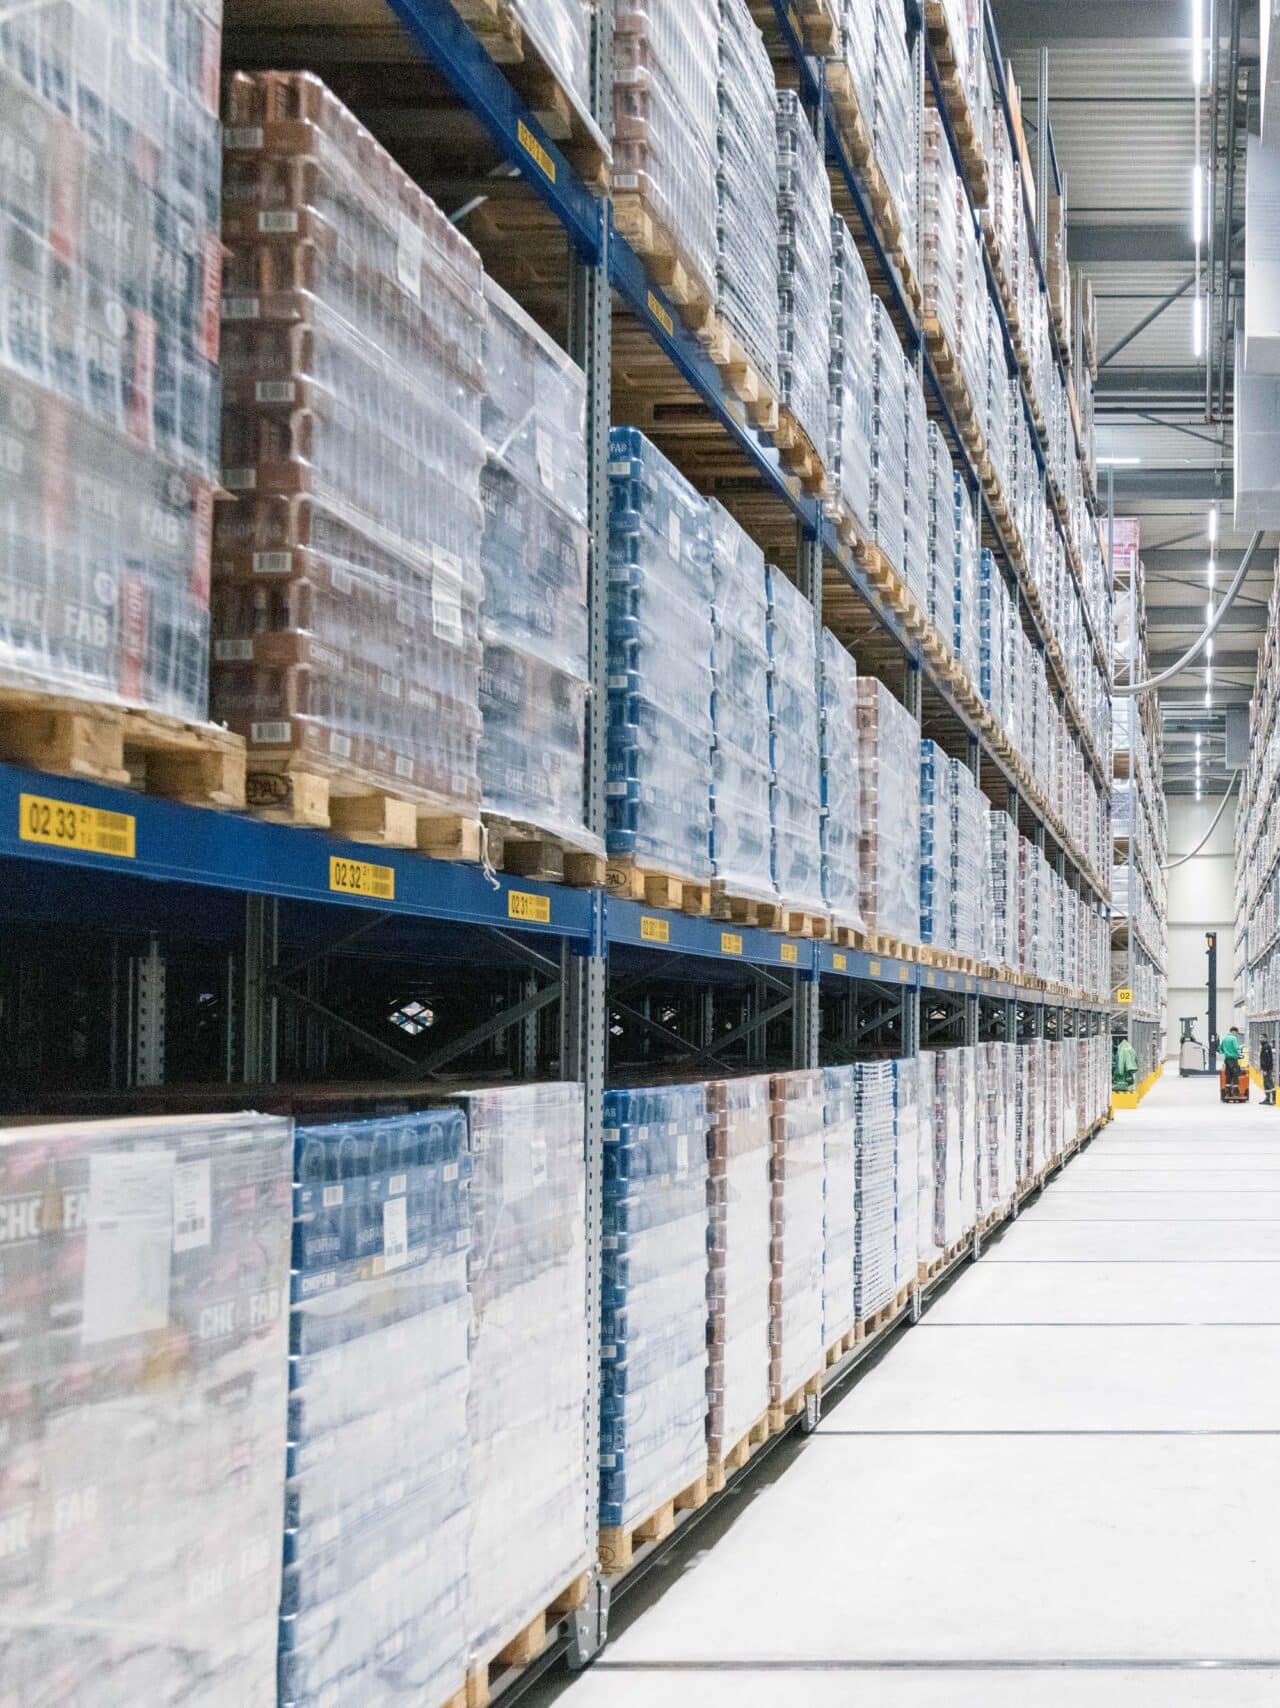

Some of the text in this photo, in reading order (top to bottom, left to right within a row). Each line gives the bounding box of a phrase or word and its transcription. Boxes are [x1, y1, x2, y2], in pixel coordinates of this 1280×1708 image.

[29, 803, 50, 836] 02
[56, 807, 76, 840] 33
[335, 861, 346, 887] 02
[350, 864, 361, 889] 32
[1120, 992, 1130, 1000] 02
